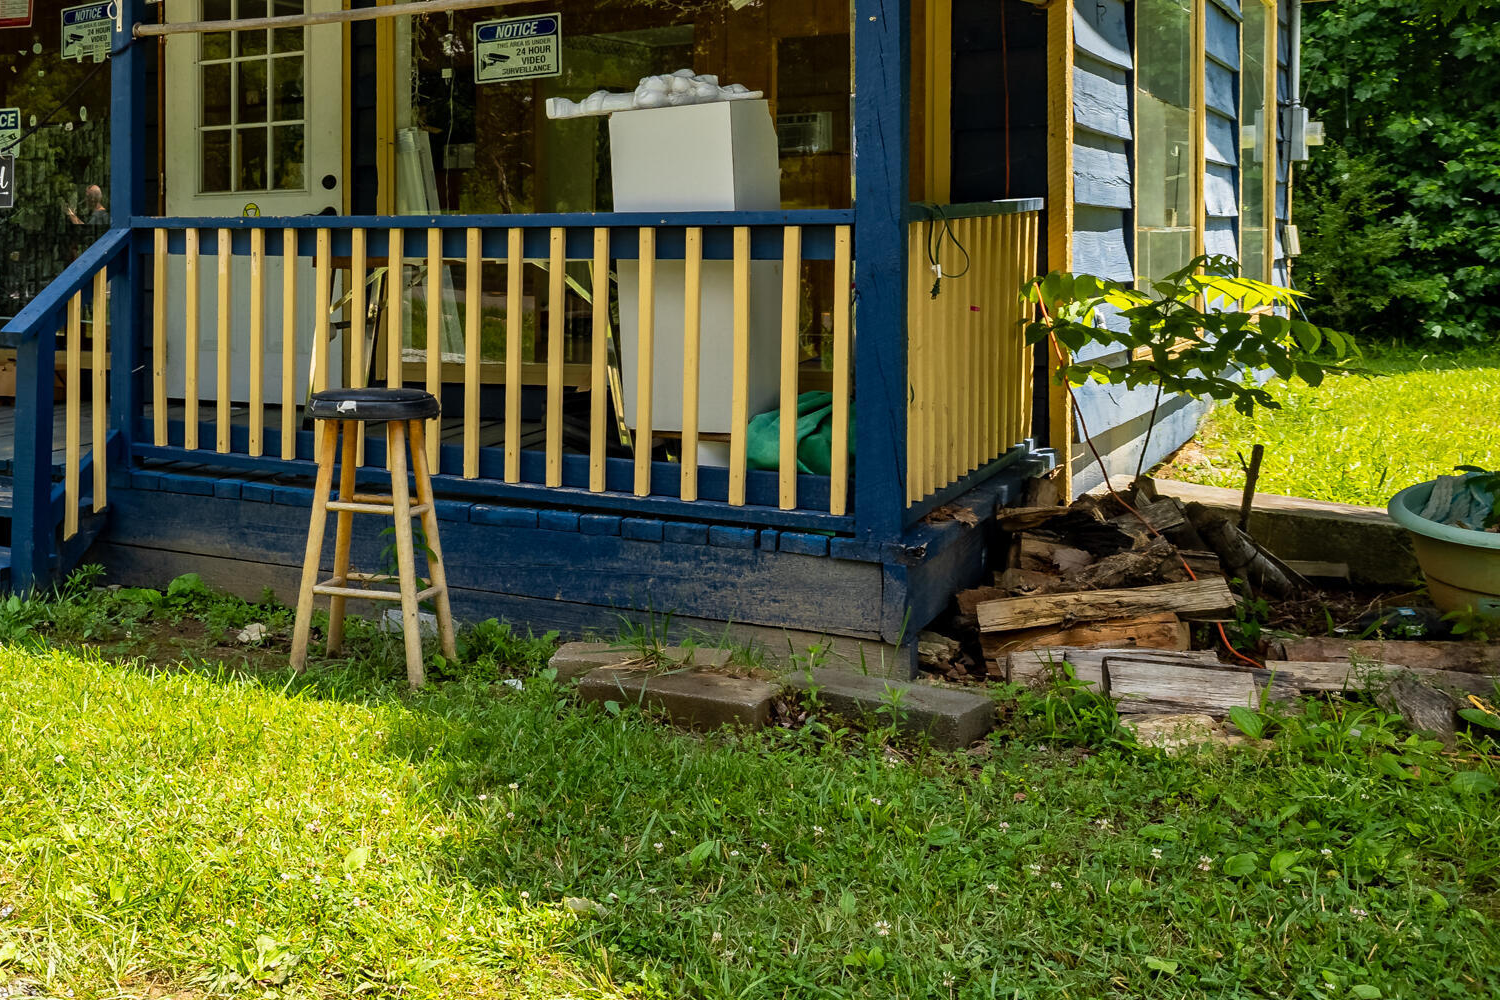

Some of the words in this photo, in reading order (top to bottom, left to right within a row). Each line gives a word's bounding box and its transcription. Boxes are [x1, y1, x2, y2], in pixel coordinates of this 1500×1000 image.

[75, 7, 102, 21] NOTICE
[96, 26, 111, 34] HOUR
[495, 21, 539, 39] NOTICE
[516, 47, 526, 56] 24
[528, 45, 551, 55] HOUR
[521, 55, 546, 65] VIDEO
[502, 64, 552, 75] SURVEILLANCE
